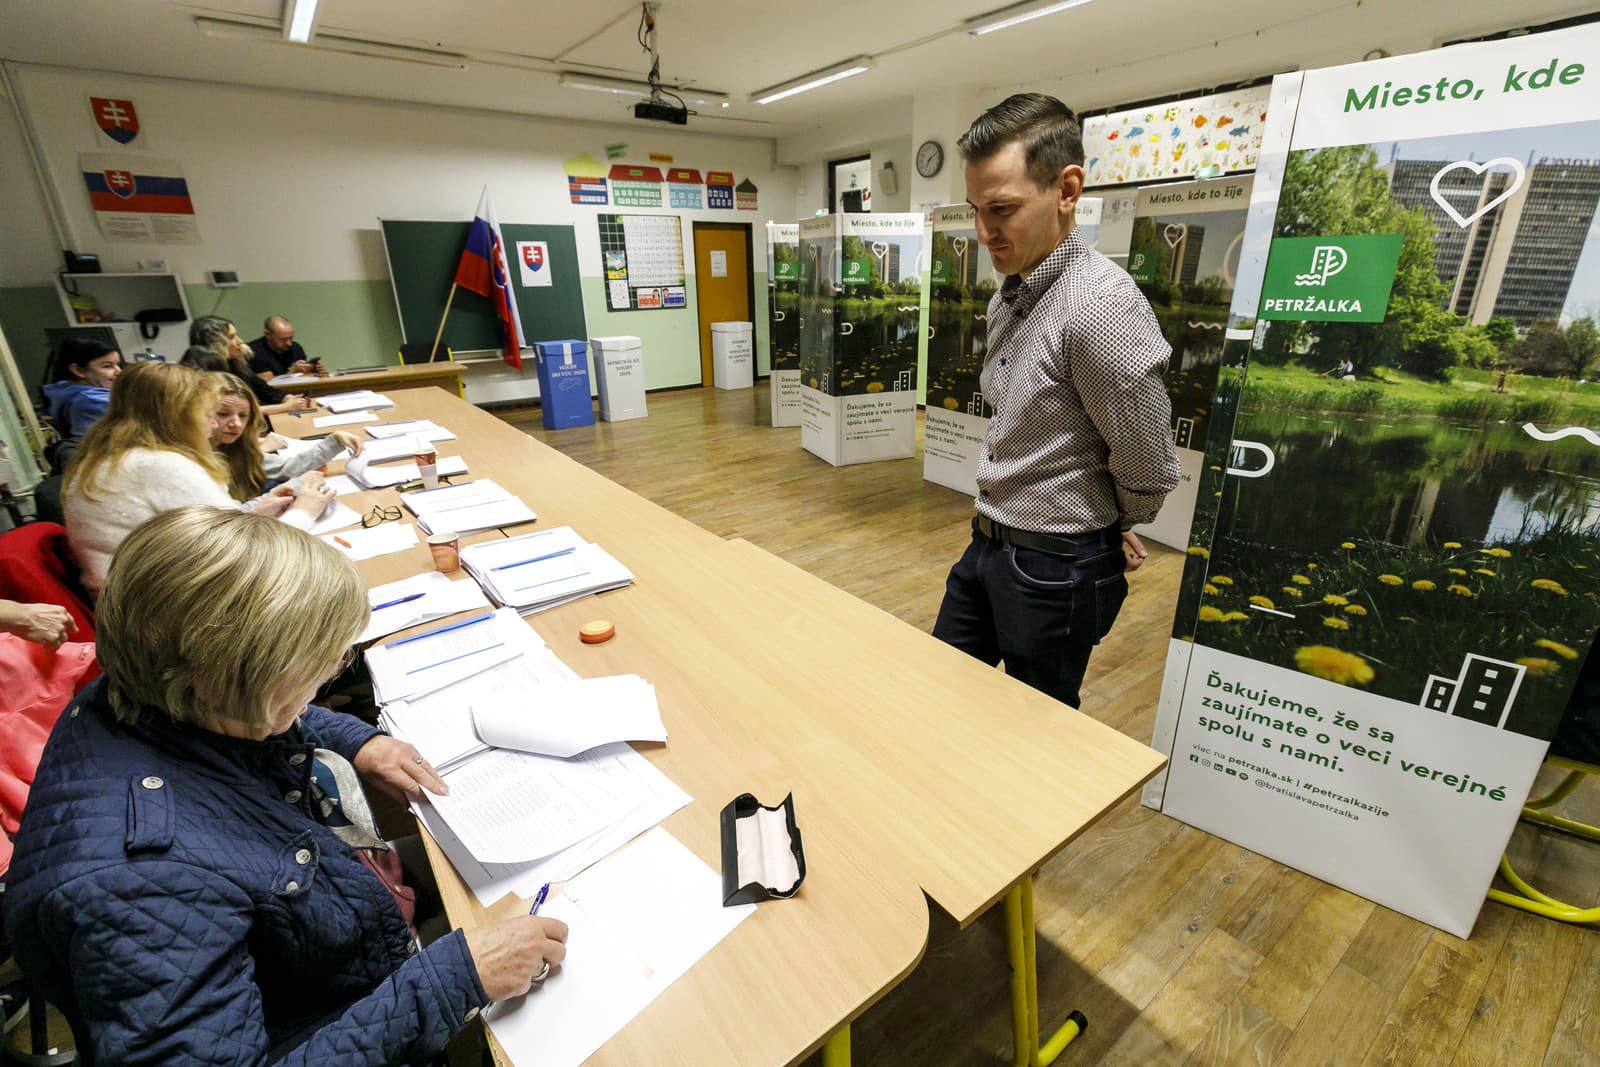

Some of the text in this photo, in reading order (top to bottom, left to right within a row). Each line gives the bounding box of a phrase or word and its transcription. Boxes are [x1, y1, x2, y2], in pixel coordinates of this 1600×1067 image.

[1343, 58, 1585, 113] Miesto, kde
[880, 219, 893, 227] kde
[895, 219, 903, 227] to
[1149, 192, 1184, 205] Miesto,
[1188, 190, 1206, 201] kde
[1209, 189, 1221, 199] to
[1224, 186, 1244, 198] žije
[1264, 296, 1362, 313] PETRŽALKA
[1206, 670, 1395, 743] Ďakujeme, že sa
[1198, 716, 1344, 773] spolu s nami.
[1201, 696, 1507, 802] zaujímate o veci verejné
[1192, 743, 1212, 755] viac
[1214, 751, 1226, 760] na
[1228, 756, 1294, 784] petrzalka.sk
[1303, 782, 1390, 818] #petrzalkazije
[1255, 779, 1360, 821] @bratislavapetrzalka
